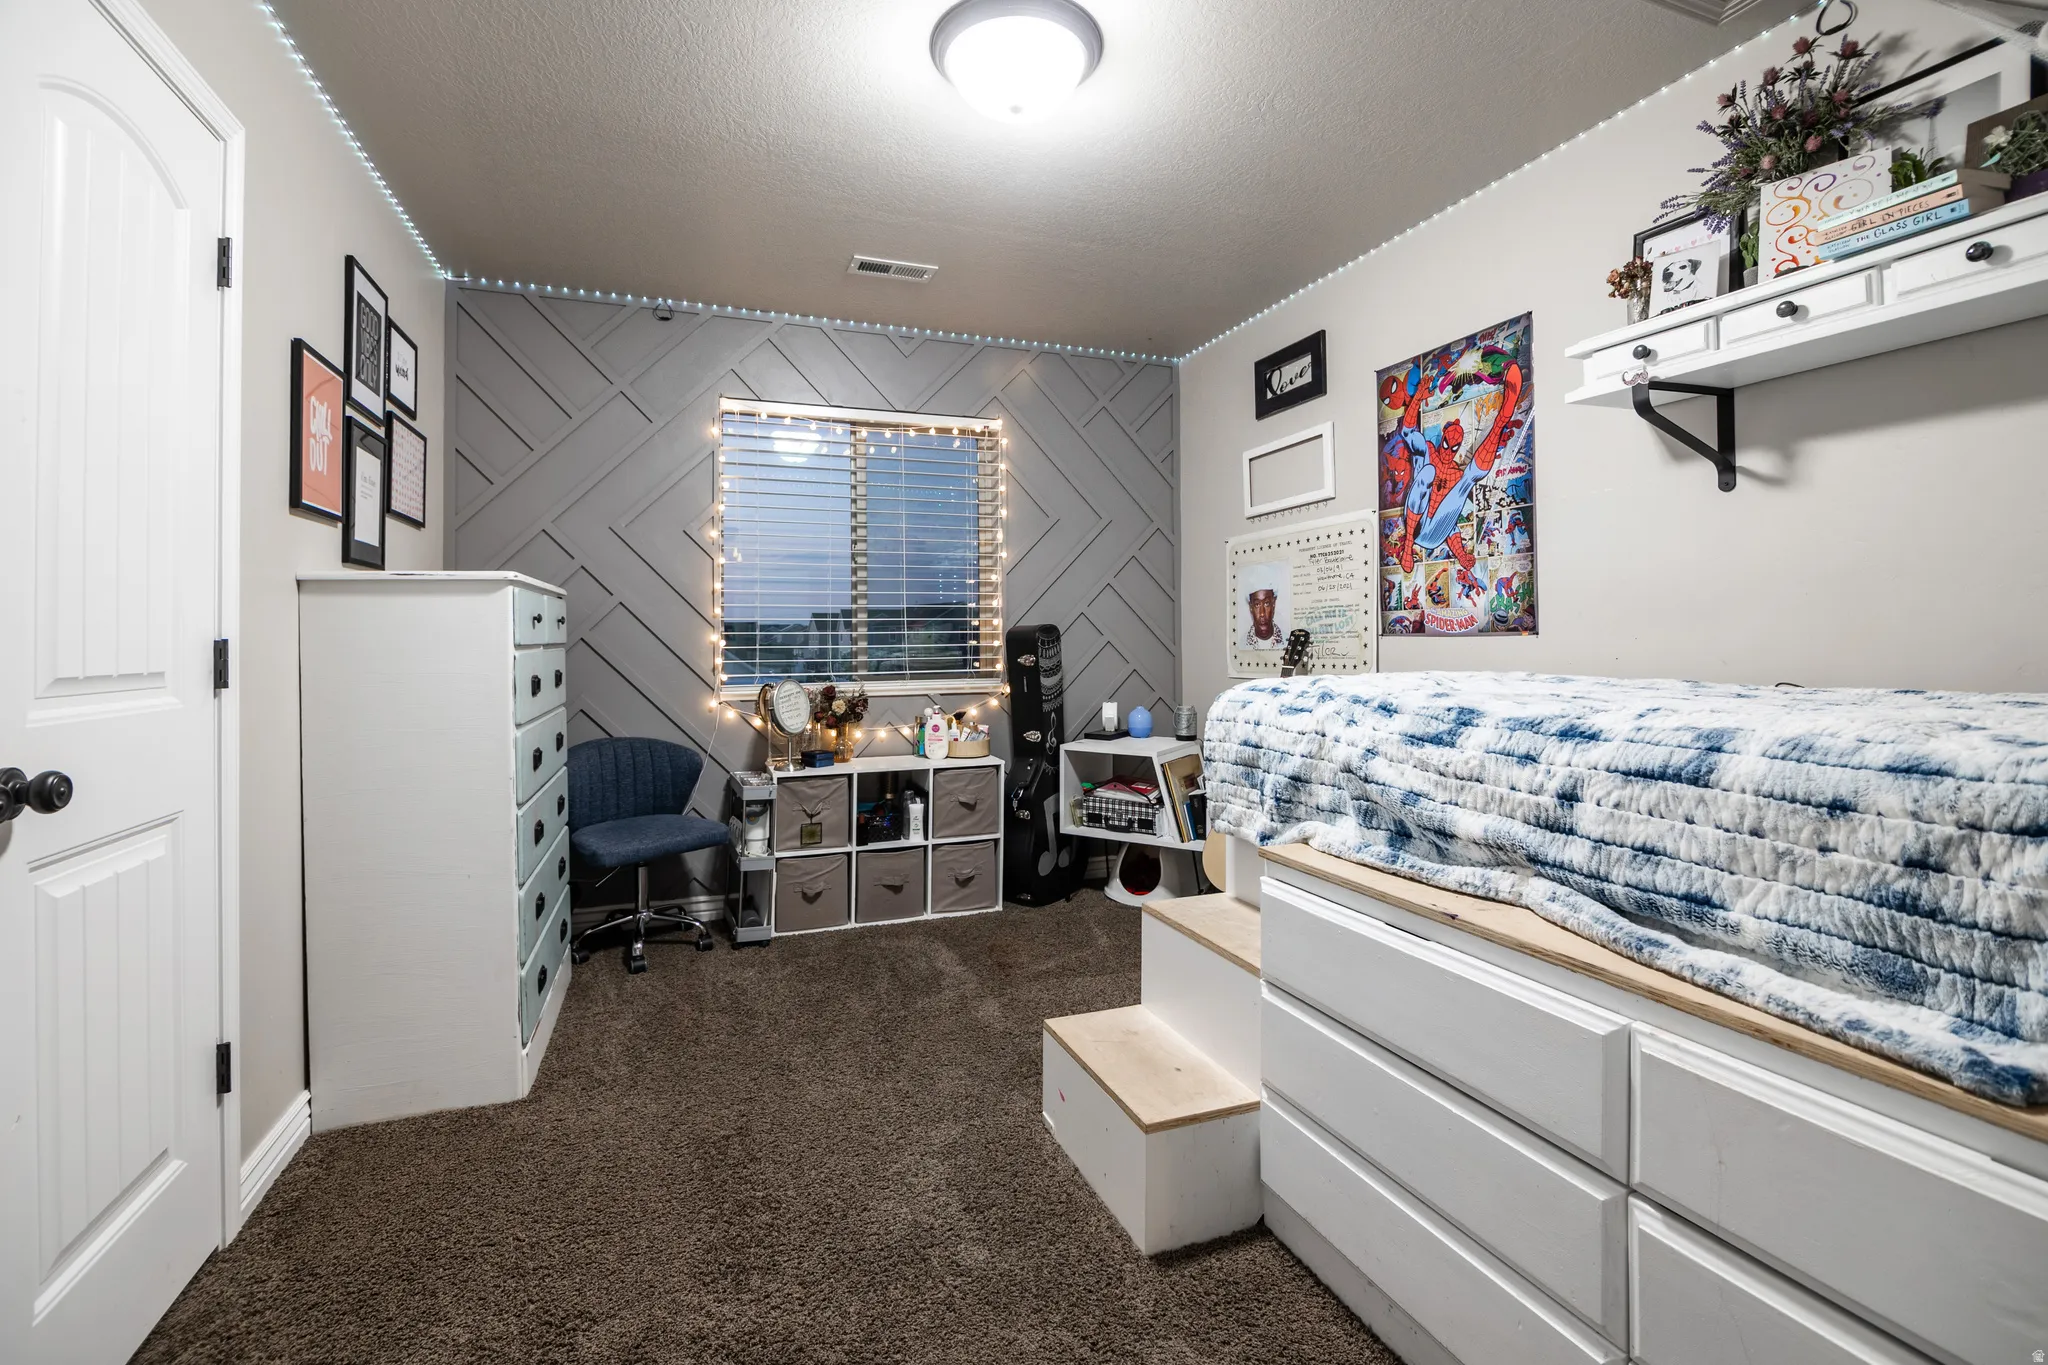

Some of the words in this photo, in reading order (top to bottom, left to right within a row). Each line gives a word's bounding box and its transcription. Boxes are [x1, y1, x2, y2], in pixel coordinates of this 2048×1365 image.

[1851, 217, 1877, 231] GIRL
[1880, 212, 1895, 222] IN
[1898, 200, 1930, 216] PIECES
[1856, 234, 1871, 243] THE
[1873, 222, 1908, 239] GLASS
[1912, 210, 1943, 226] GIRL
[360, 302, 379, 341] GOOD
[360, 353, 378, 389] ONLY
[1265, 362, 1311, 396] Love
[310, 395, 333, 441] CHILL
[309, 436, 330, 476] OUT
[1425, 612, 1479, 632] SPIDER-MAN
